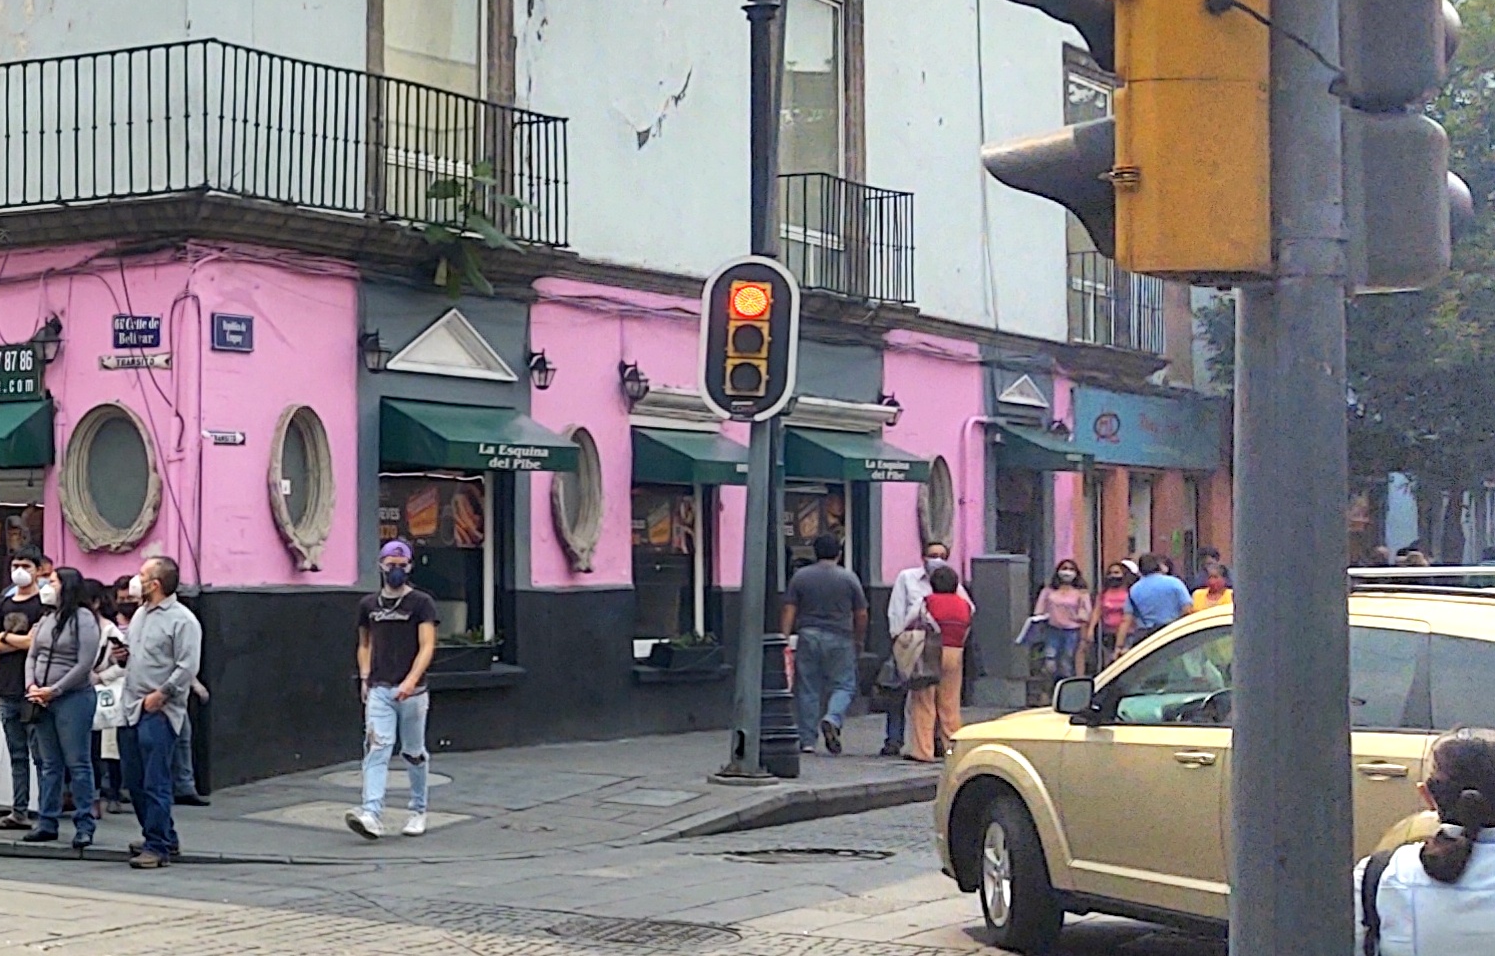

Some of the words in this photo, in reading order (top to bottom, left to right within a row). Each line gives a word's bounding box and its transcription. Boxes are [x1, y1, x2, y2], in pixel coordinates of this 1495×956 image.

[4, 351, 17, 372] 87
[19, 350, 33, 371] 86
[479, 443, 495, 455] La
[498, 445, 549, 458] Esquina
[488, 457, 508, 469] del
[513, 459, 541, 470] Pibe
[865, 460, 875, 469] La
[871, 470, 885, 479] del
